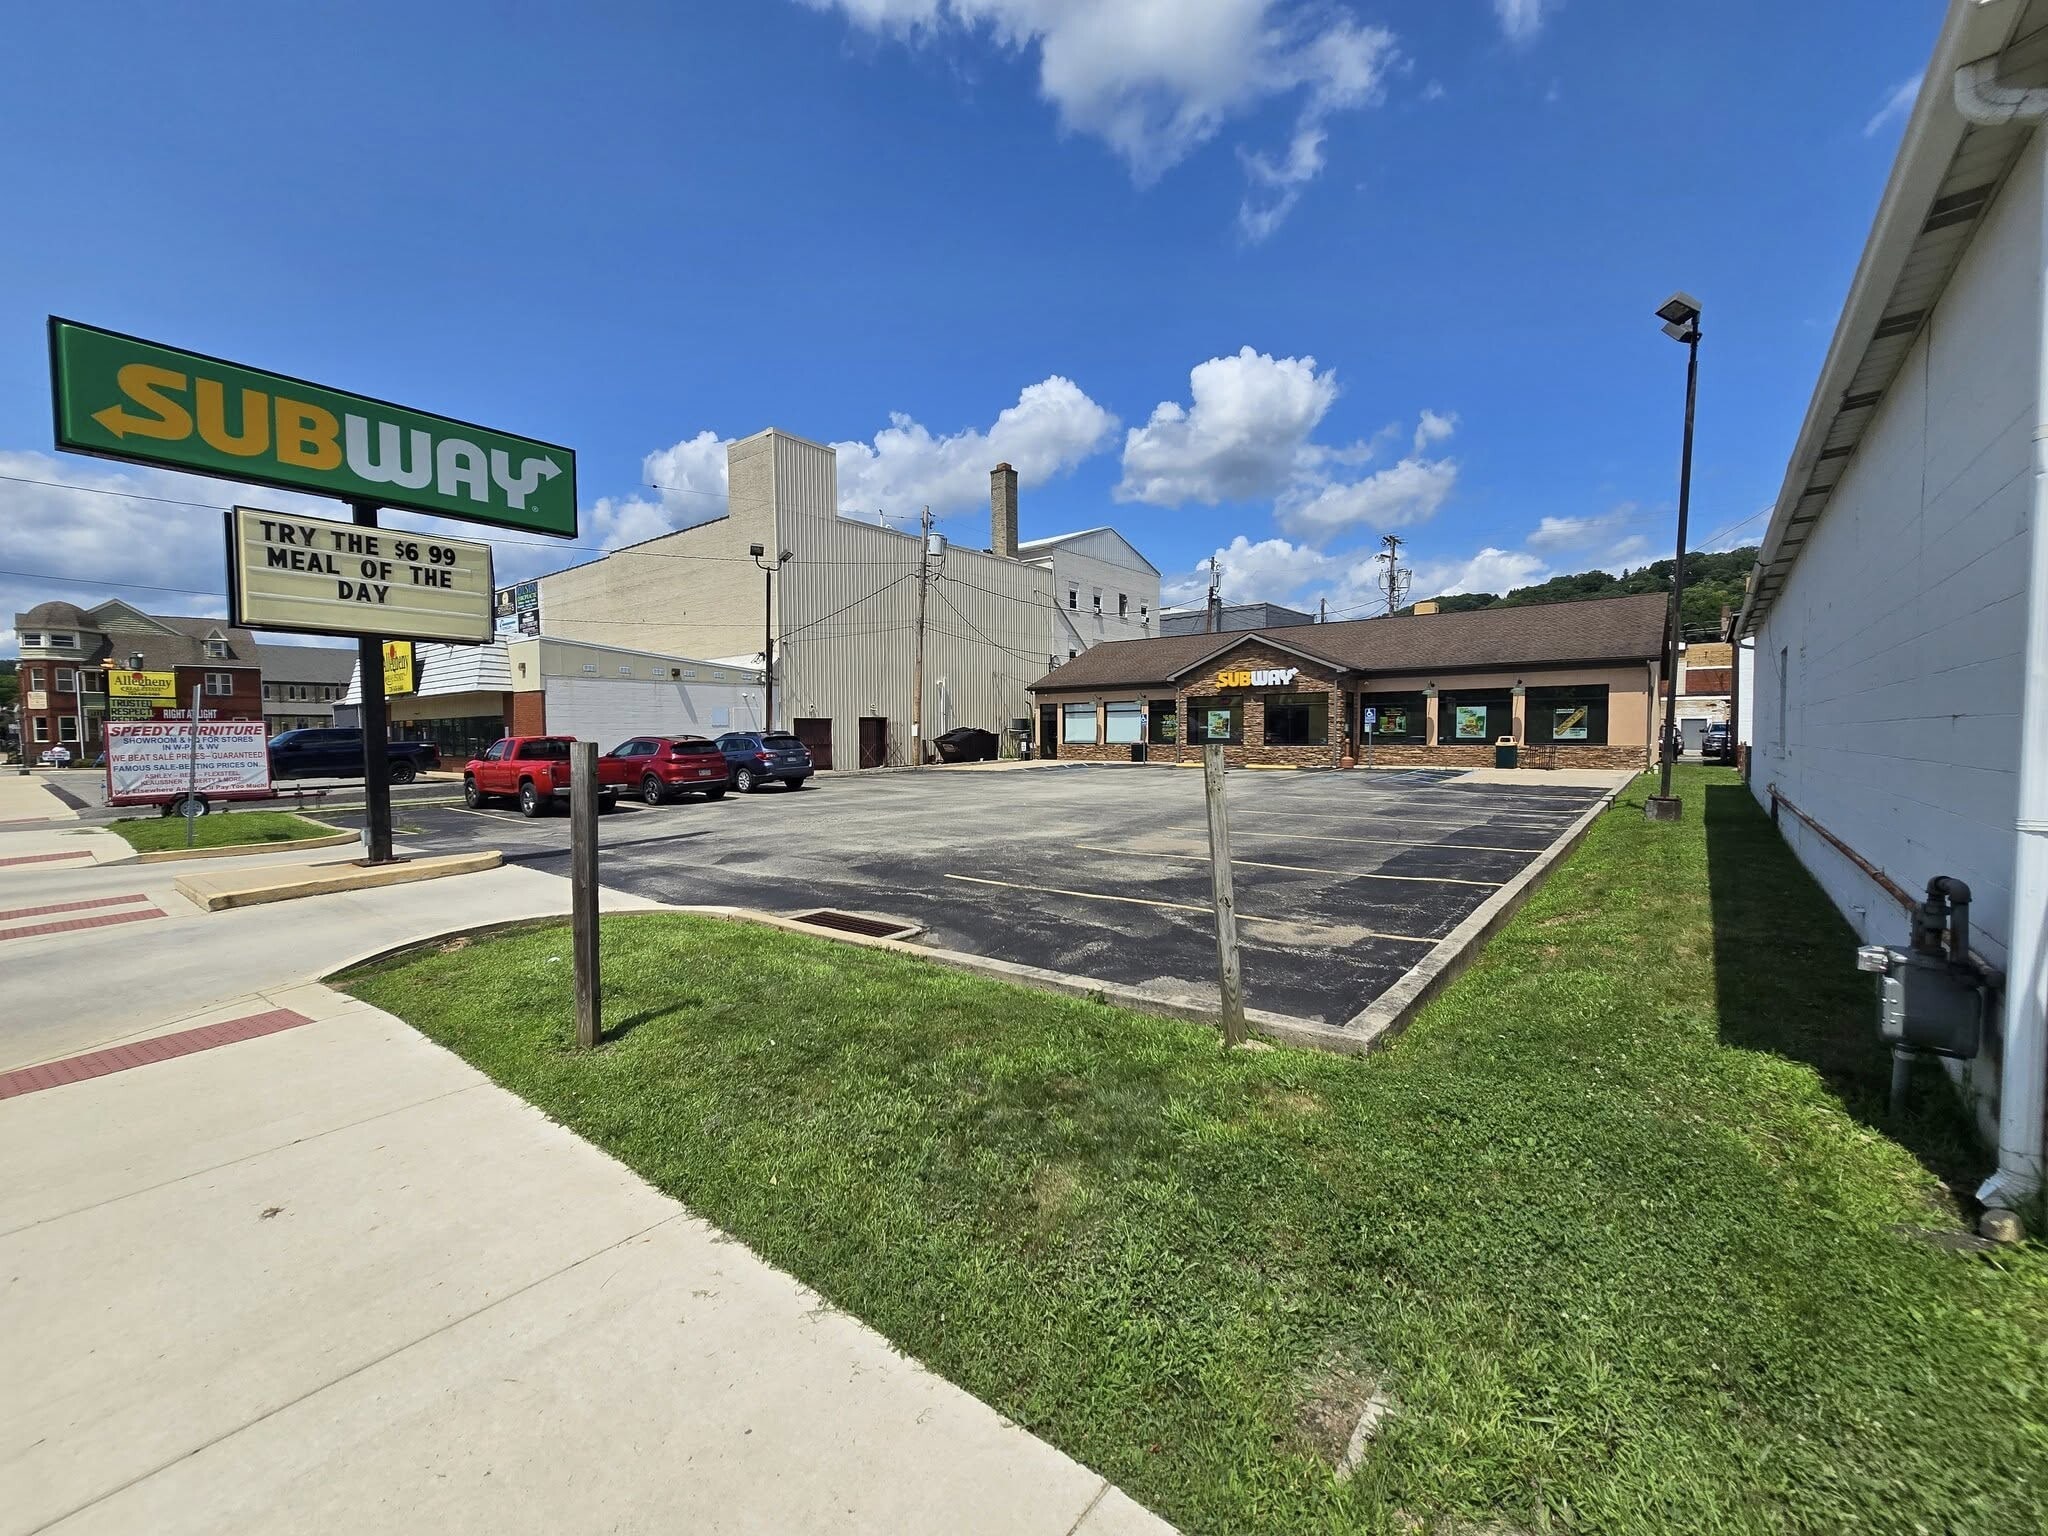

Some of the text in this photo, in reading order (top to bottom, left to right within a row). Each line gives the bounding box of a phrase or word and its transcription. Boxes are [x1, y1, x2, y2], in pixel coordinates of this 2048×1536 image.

[91, 363, 562, 510] SUBWAY
[259, 520, 316, 546] TRY
[330, 531, 379, 556] THE
[267, 547, 452, 588] MEAL OF THE
[338, 581, 389, 604] DAY
[114, 675, 172, 690] Allegheny
[1216, 667, 1299, 689] SUBWAY
[163, 709, 185, 719] RIGHT
[110, 726, 174, 737] SPEEDY
[153, 762, 214, 770] SALE-BETING
